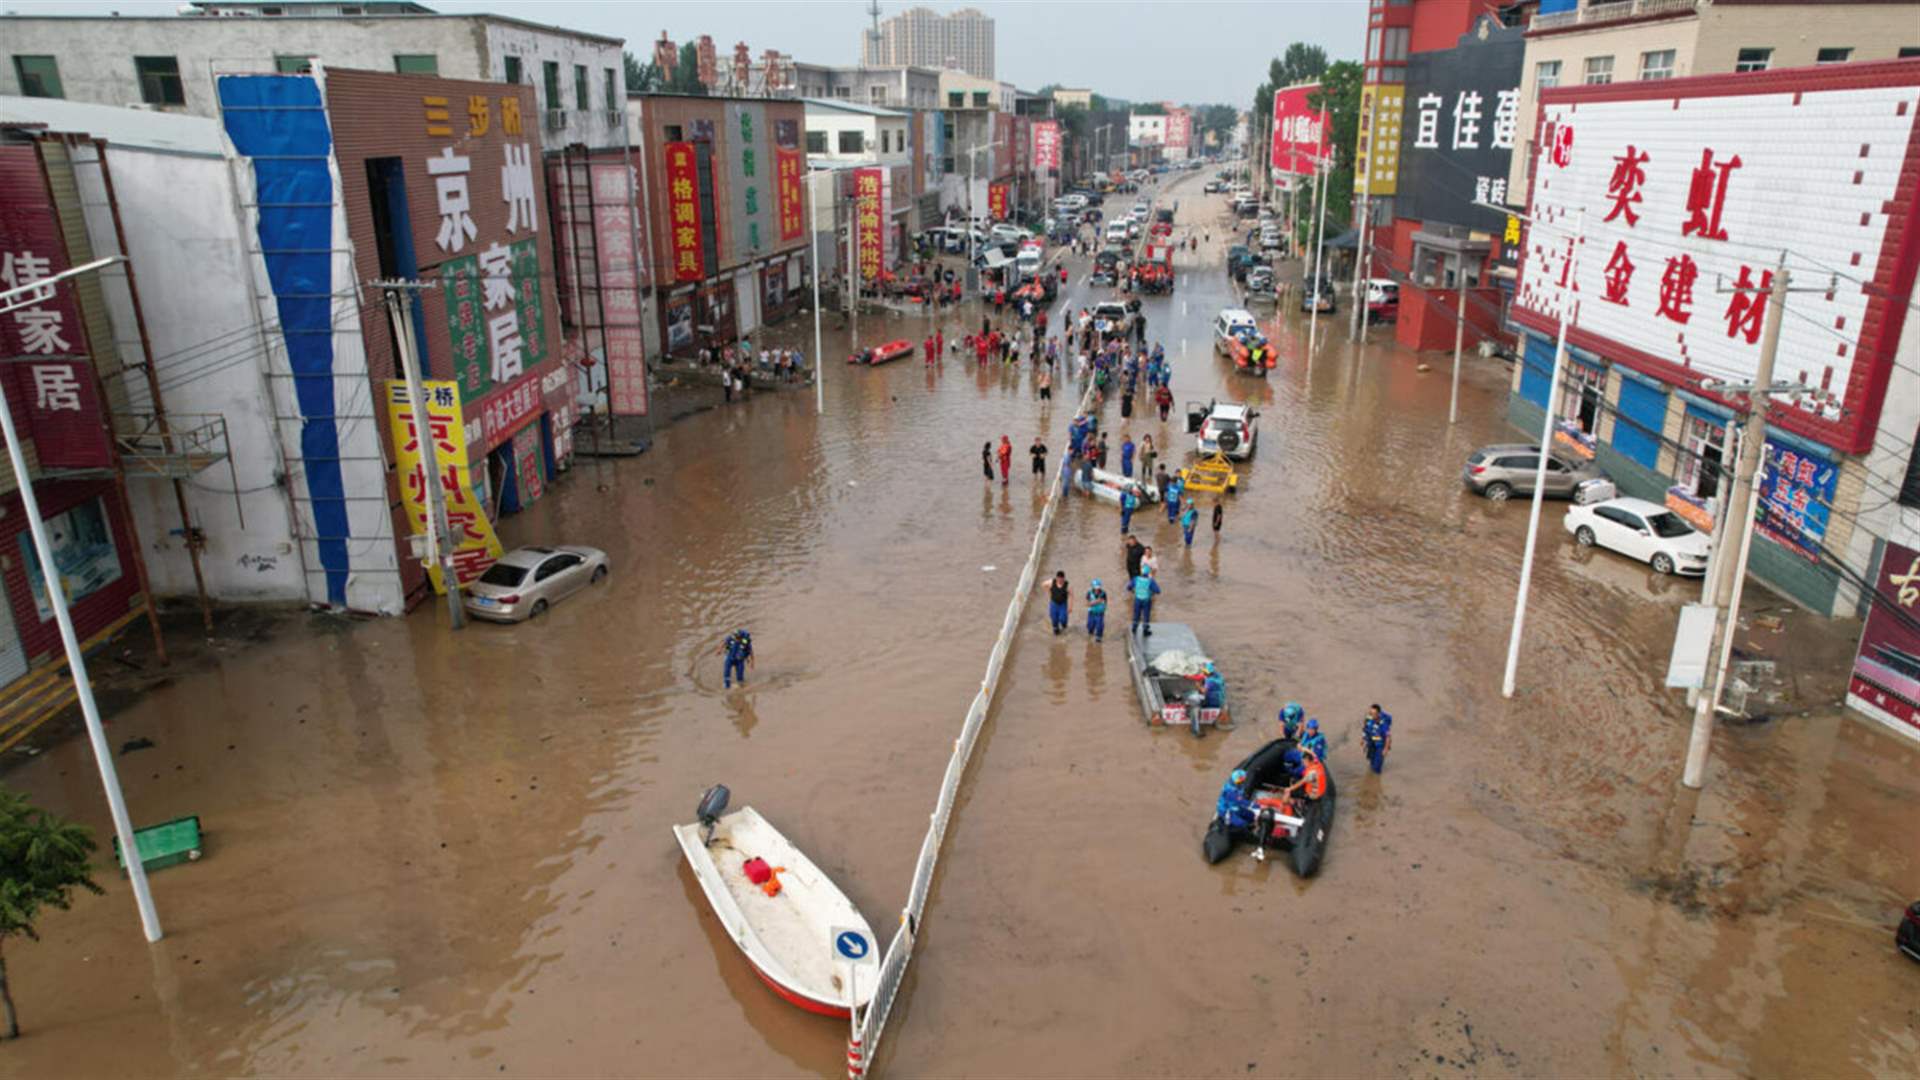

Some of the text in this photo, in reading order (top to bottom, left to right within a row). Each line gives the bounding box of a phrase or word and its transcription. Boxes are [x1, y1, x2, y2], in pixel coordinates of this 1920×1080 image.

[423, 96, 523, 137] 三步桥
[1414, 88, 1519, 150] 宜佳建
[1603, 144, 1742, 241] 奕虹
